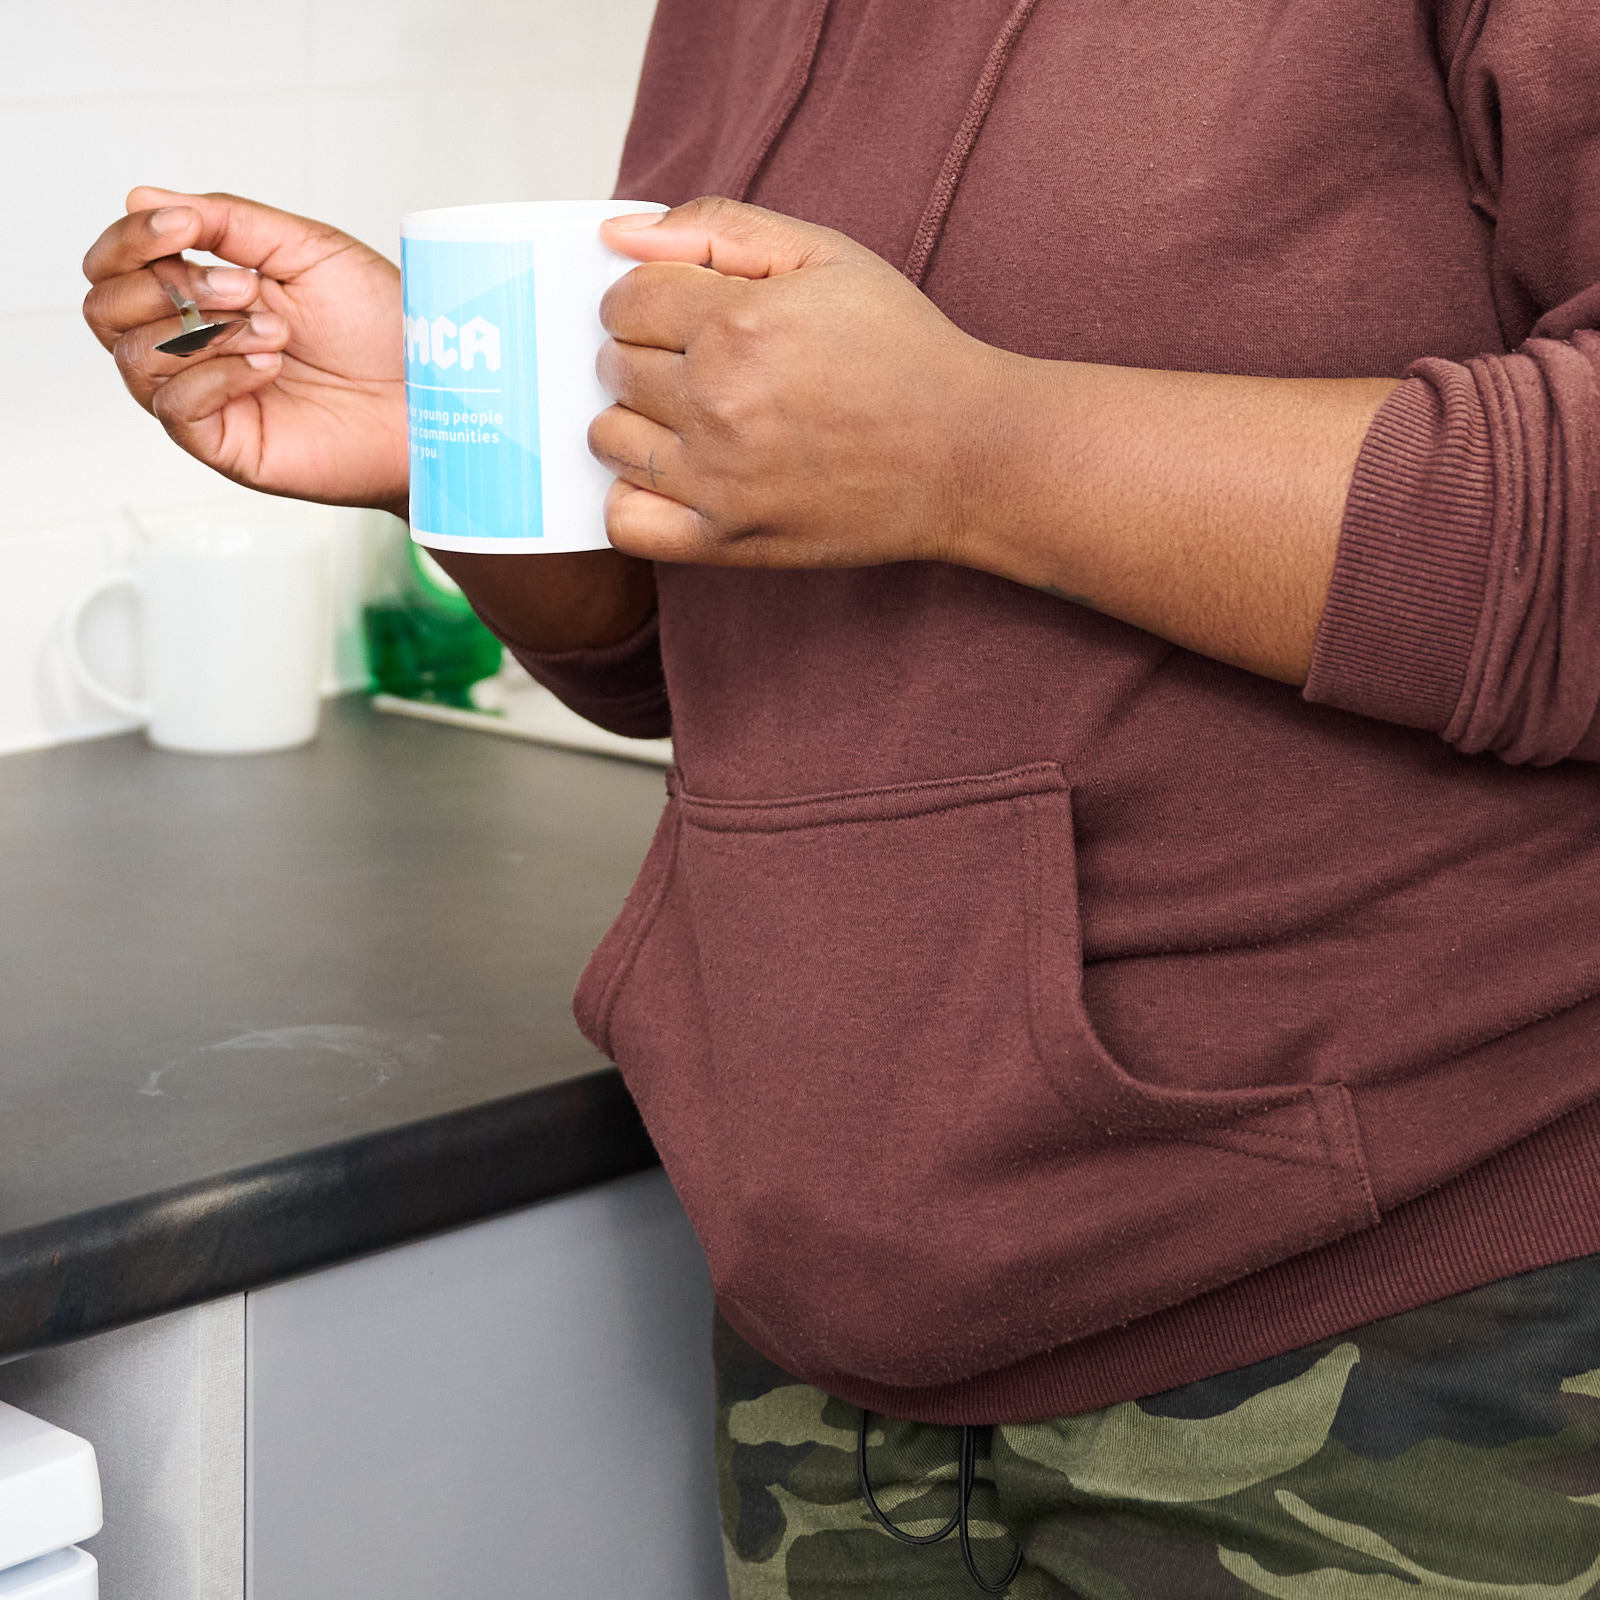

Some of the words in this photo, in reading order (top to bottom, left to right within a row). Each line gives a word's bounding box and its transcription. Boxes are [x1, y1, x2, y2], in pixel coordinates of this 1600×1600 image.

[403, 313, 501, 372] MCA
[418, 408, 450, 426] young
[453, 409, 504, 427] people
[419, 427, 500, 444] communities
[420, 446, 437, 460] you
